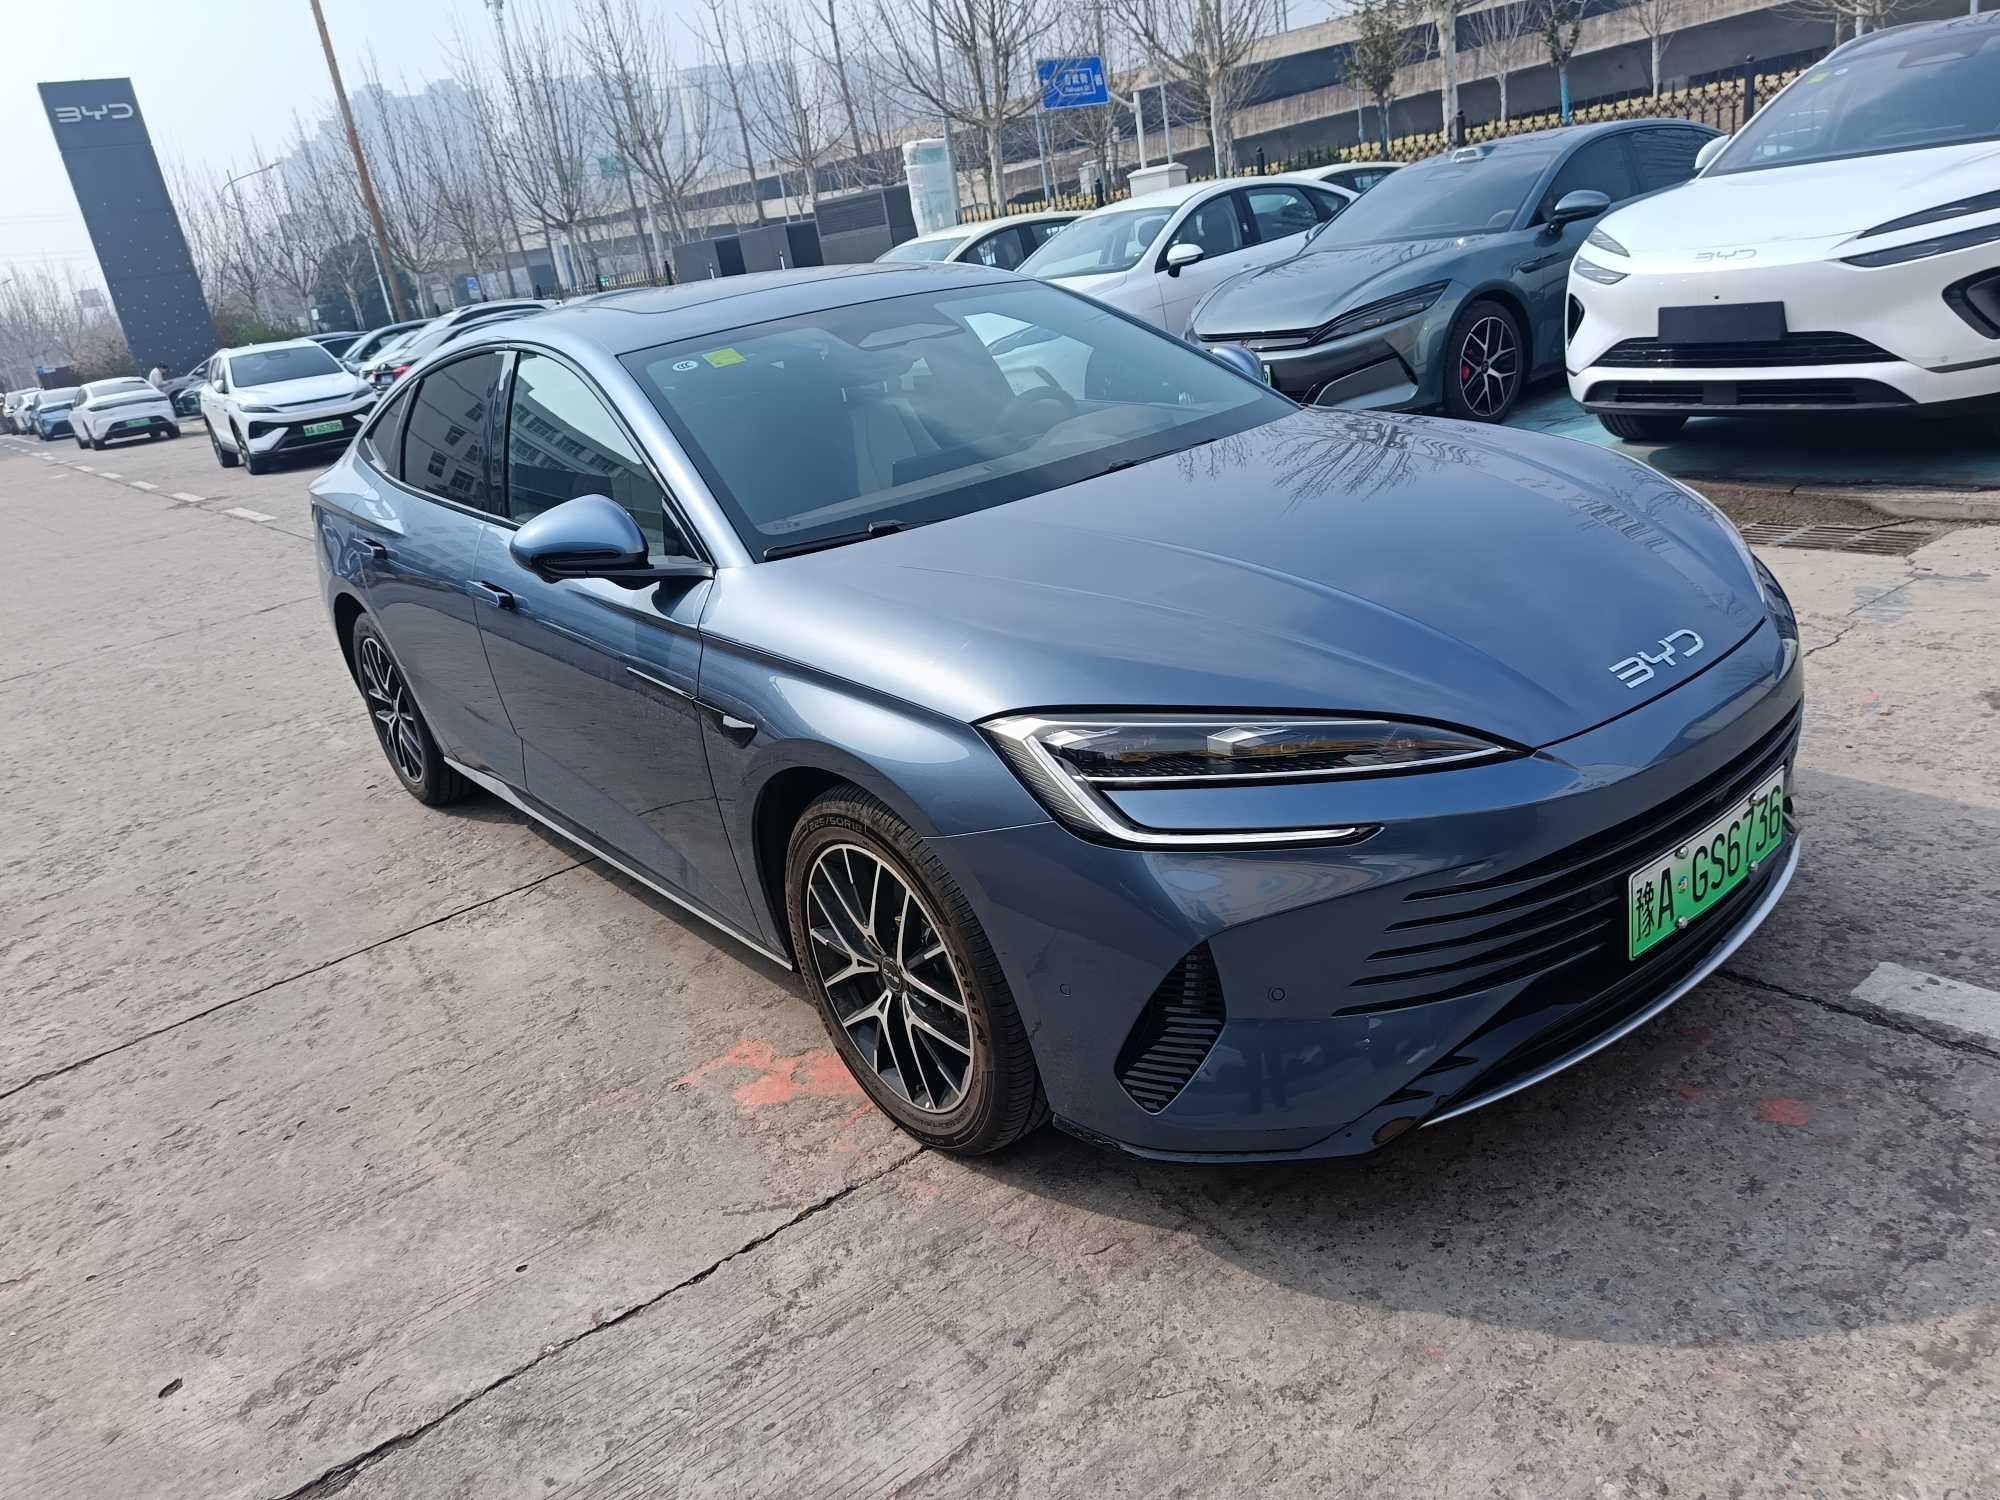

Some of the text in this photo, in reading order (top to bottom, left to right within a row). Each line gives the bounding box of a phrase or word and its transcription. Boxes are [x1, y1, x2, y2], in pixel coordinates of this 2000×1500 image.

[55, 103, 134, 123] BYD
[1693, 249, 1758, 263] BYD
[1607, 628, 1704, 689] BYD
